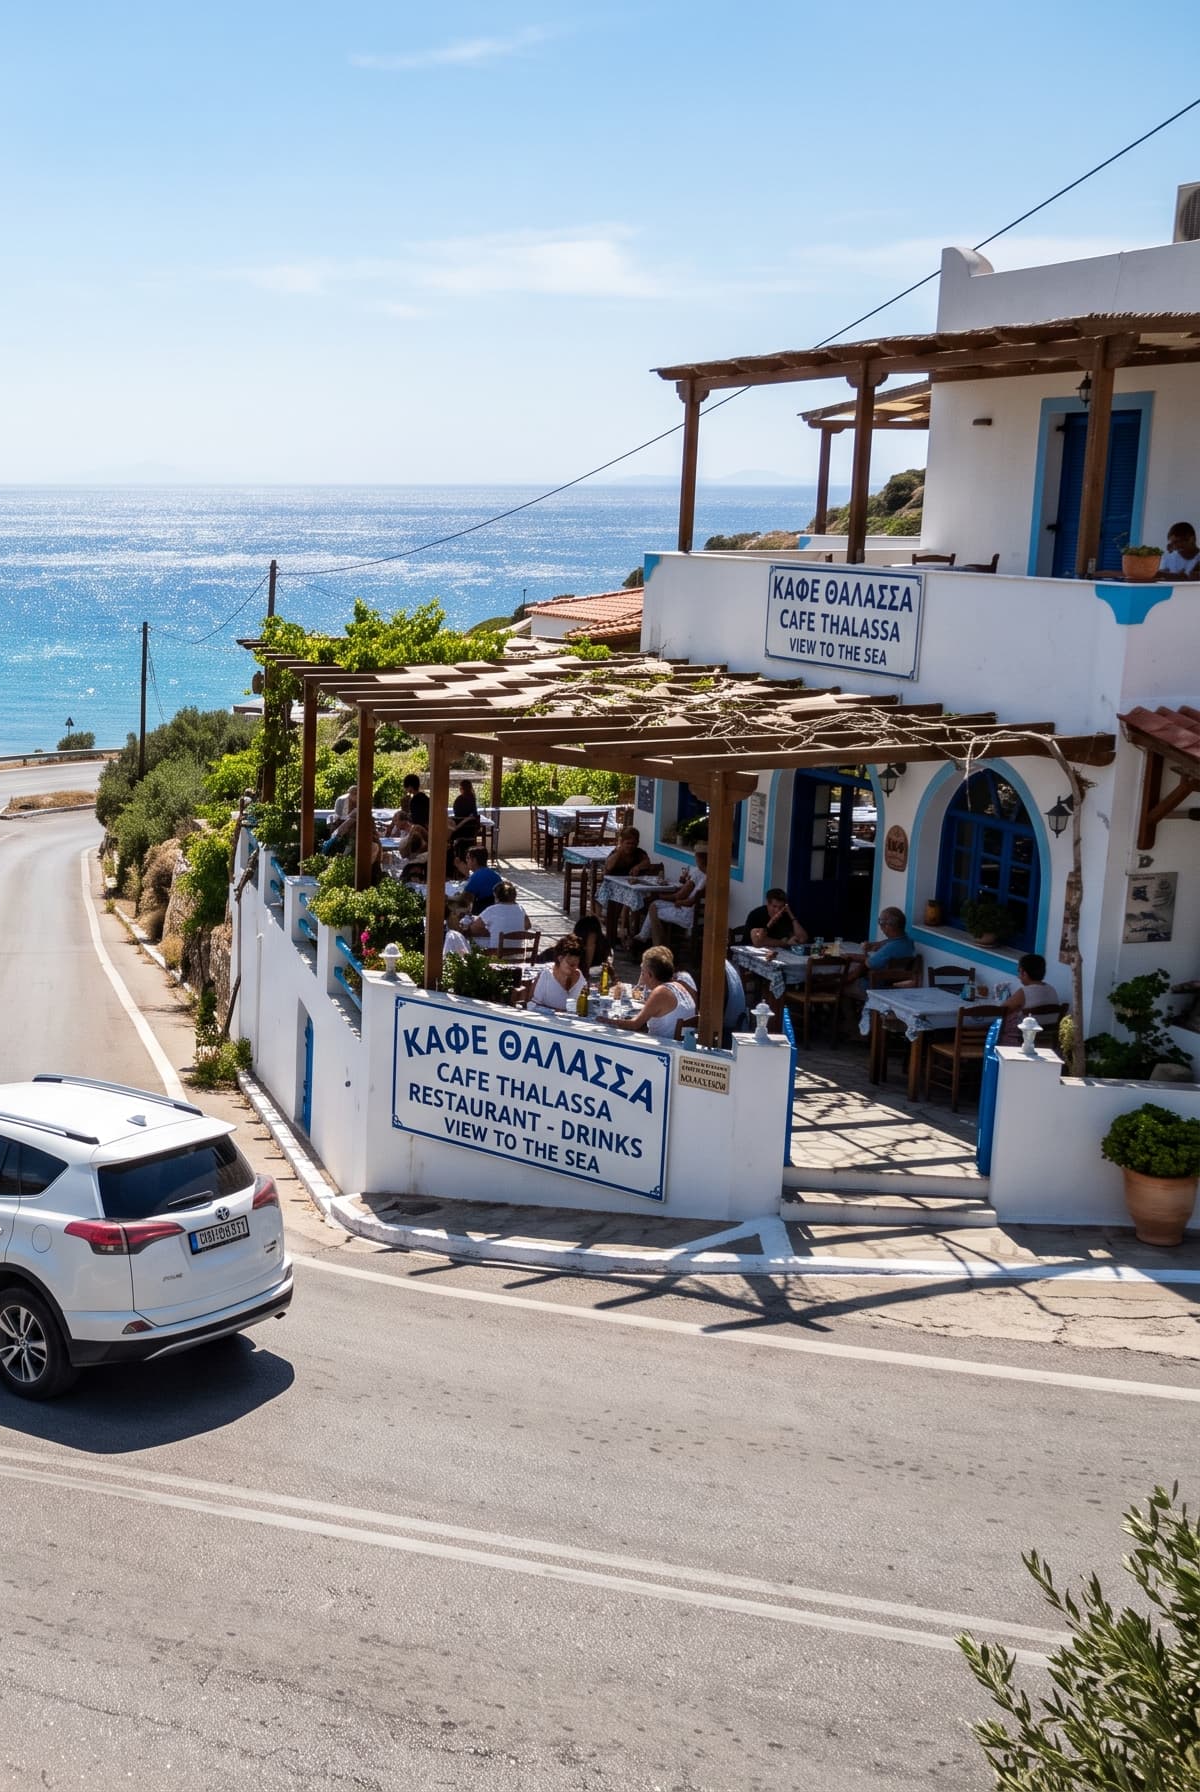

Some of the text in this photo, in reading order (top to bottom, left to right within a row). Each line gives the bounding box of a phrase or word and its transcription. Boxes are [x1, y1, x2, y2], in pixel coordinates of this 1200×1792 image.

[773, 575, 913, 613] ΚΑΦΕ ΘΑΛΑΣΣΑ
[780, 609, 901, 643] CAFE THALASSA
[789, 637, 887, 666] VIEW TO THE SEA
[403, 1022, 653, 1113] ΚΑΦΕ ΘΑΛΑΣΣΑ
[437, 1062, 613, 1122] CAFE THALASSA
[409, 1082, 541, 1132] RESTAURANT
[561, 1120, 643, 1159] DRINKS
[444, 1117, 600, 1174] VIEW TO THE SEA
